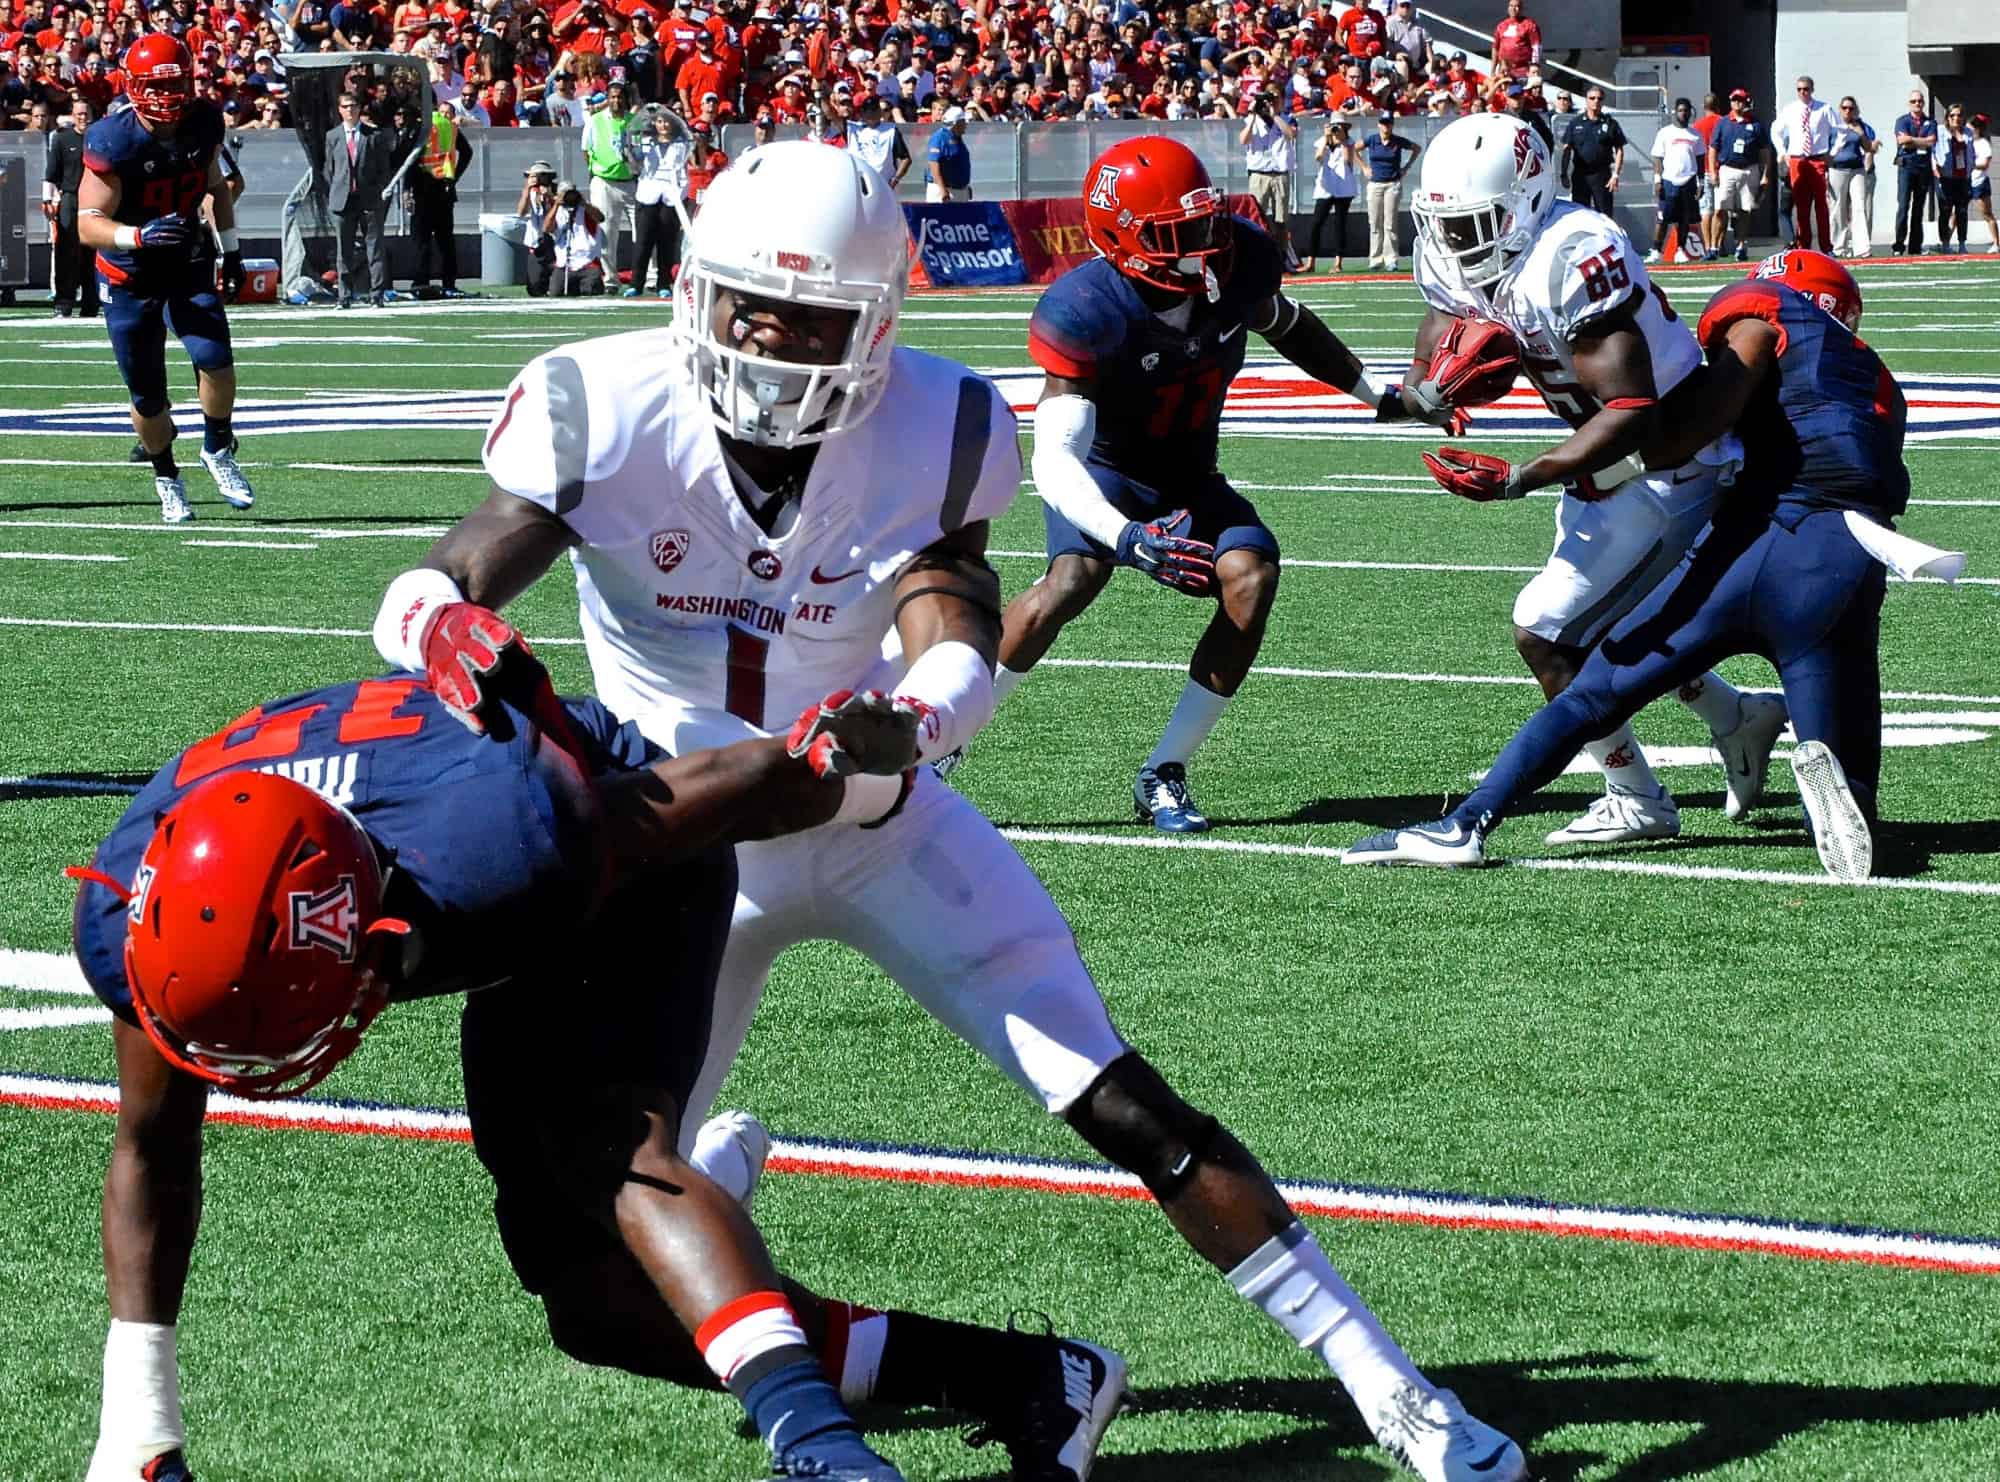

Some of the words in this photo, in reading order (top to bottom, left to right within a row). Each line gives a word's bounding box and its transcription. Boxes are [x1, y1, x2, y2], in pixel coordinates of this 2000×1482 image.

[1089, 165, 1121, 211] A
[926, 219, 990, 244] Game
[777, 250, 811, 272] WSU
[924, 245, 1013, 274] Sponsor
[1578, 244, 1631, 303] 85
[253, 275, 266, 293] G
[653, 532, 689, 558] PAC
[659, 549, 678, 566] 12
[656, 592, 787, 635] WASHINGTON
[793, 601, 838, 625] ATE
[724, 623, 770, 729] 1
[288, 873, 358, 963] A
[1058, 1349, 1092, 1422] NIKE
